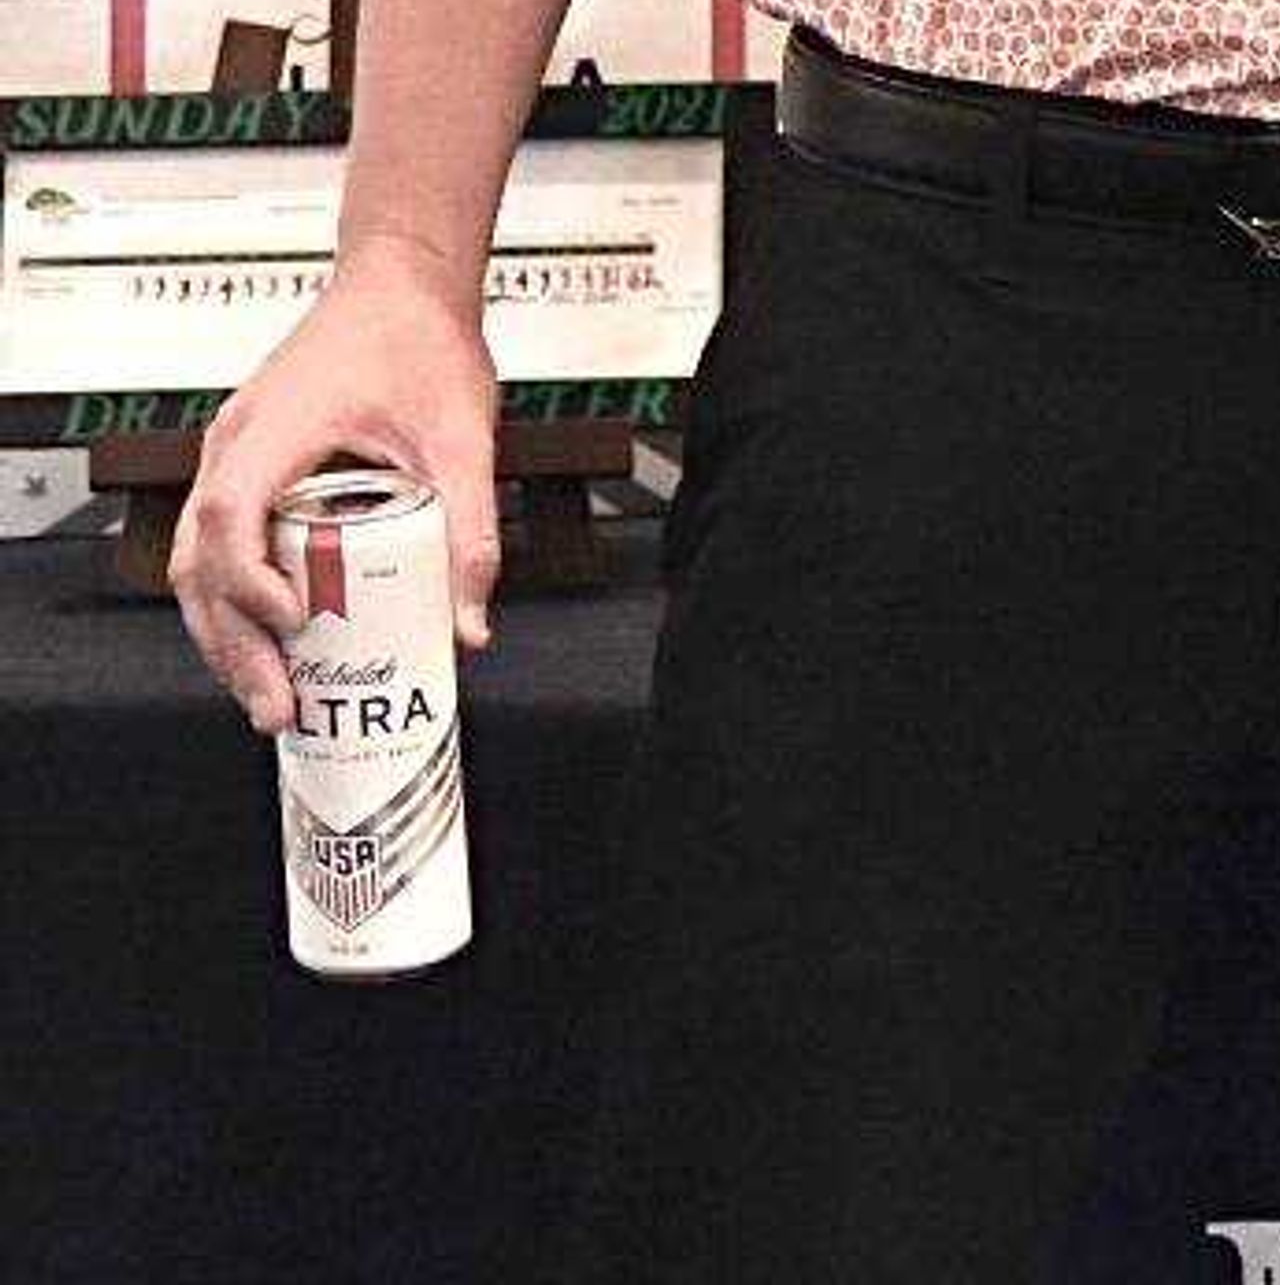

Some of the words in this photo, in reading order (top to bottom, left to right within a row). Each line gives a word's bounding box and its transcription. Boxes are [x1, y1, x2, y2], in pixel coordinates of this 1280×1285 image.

[11, 91, 321, 146] SUNDAY
[294, 687, 434, 738] LTRA
[315, 840, 376, 876] USA
